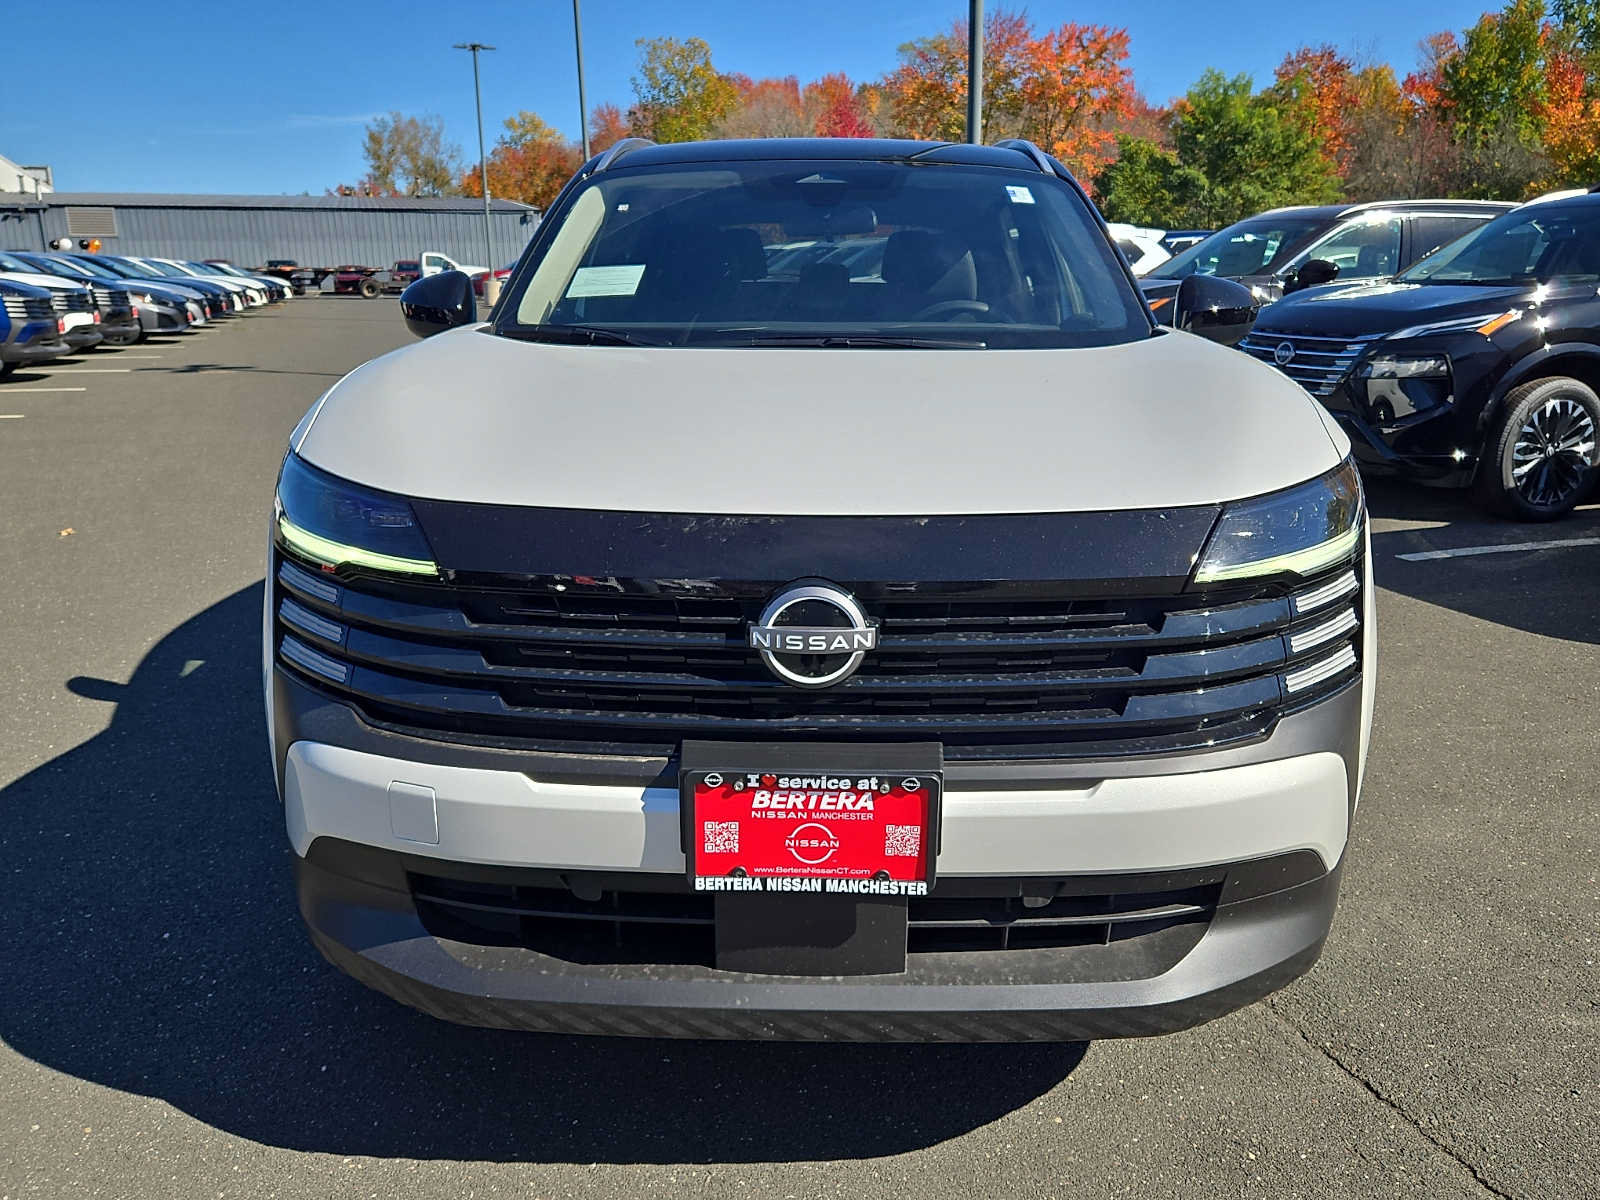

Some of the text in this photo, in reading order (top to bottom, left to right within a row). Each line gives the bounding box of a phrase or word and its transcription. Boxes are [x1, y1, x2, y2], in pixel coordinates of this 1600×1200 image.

[752, 631, 872, 651] NISSAN
[747, 774, 878, 790] I service at
[752, 790, 875, 811] BERTERA
[751, 810, 874, 821] NISSAN MANCHESTER
[785, 839, 840, 848] NISSAN
[753, 866, 871, 875] www.BerteraNissanCT.com
[695, 877, 928, 895] BERTERA NISSAN MANCHESTER
